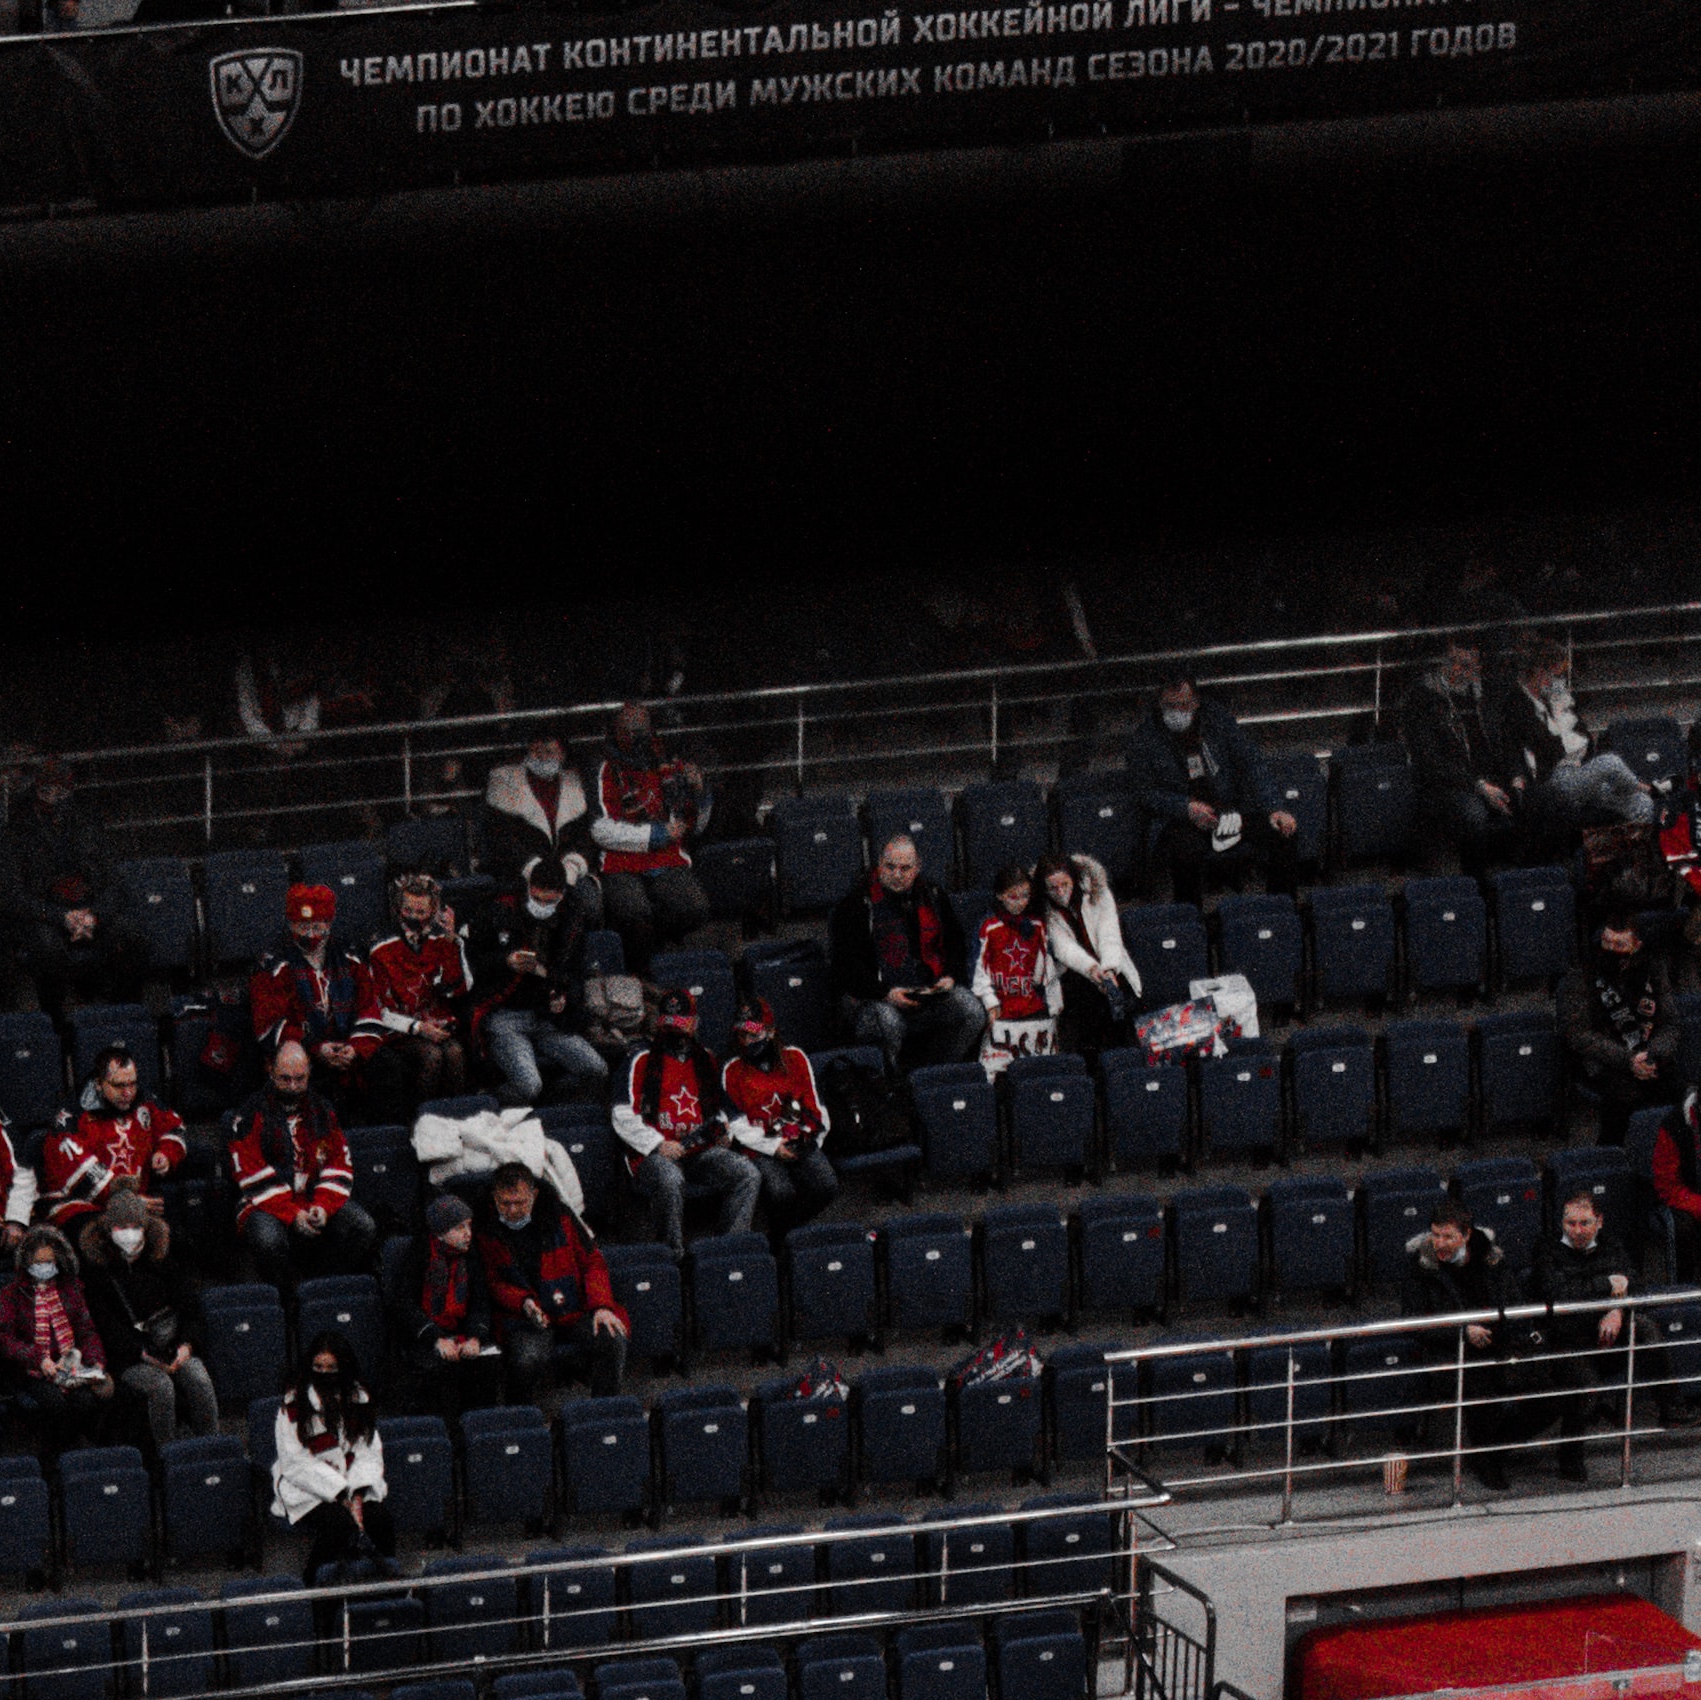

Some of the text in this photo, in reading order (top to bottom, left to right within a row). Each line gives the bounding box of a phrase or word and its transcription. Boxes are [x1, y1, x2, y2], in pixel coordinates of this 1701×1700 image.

[340, 43, 553, 87] ЧЕМПИОНАТ
[563, 9, 902, 70] КОНТИНЕНТАЛЬНОЙ
[912, 0, 1114, 43] ХОККЕЙНОЙ
[1123, 0, 1214, 28] ЛИГИ
[416, 21, 1517, 132] ПО ХОККЕЮ СРЕДИ МУЖСКИХ КОМАНД СЕЗОНА 2020/2021 ГОДОВ
